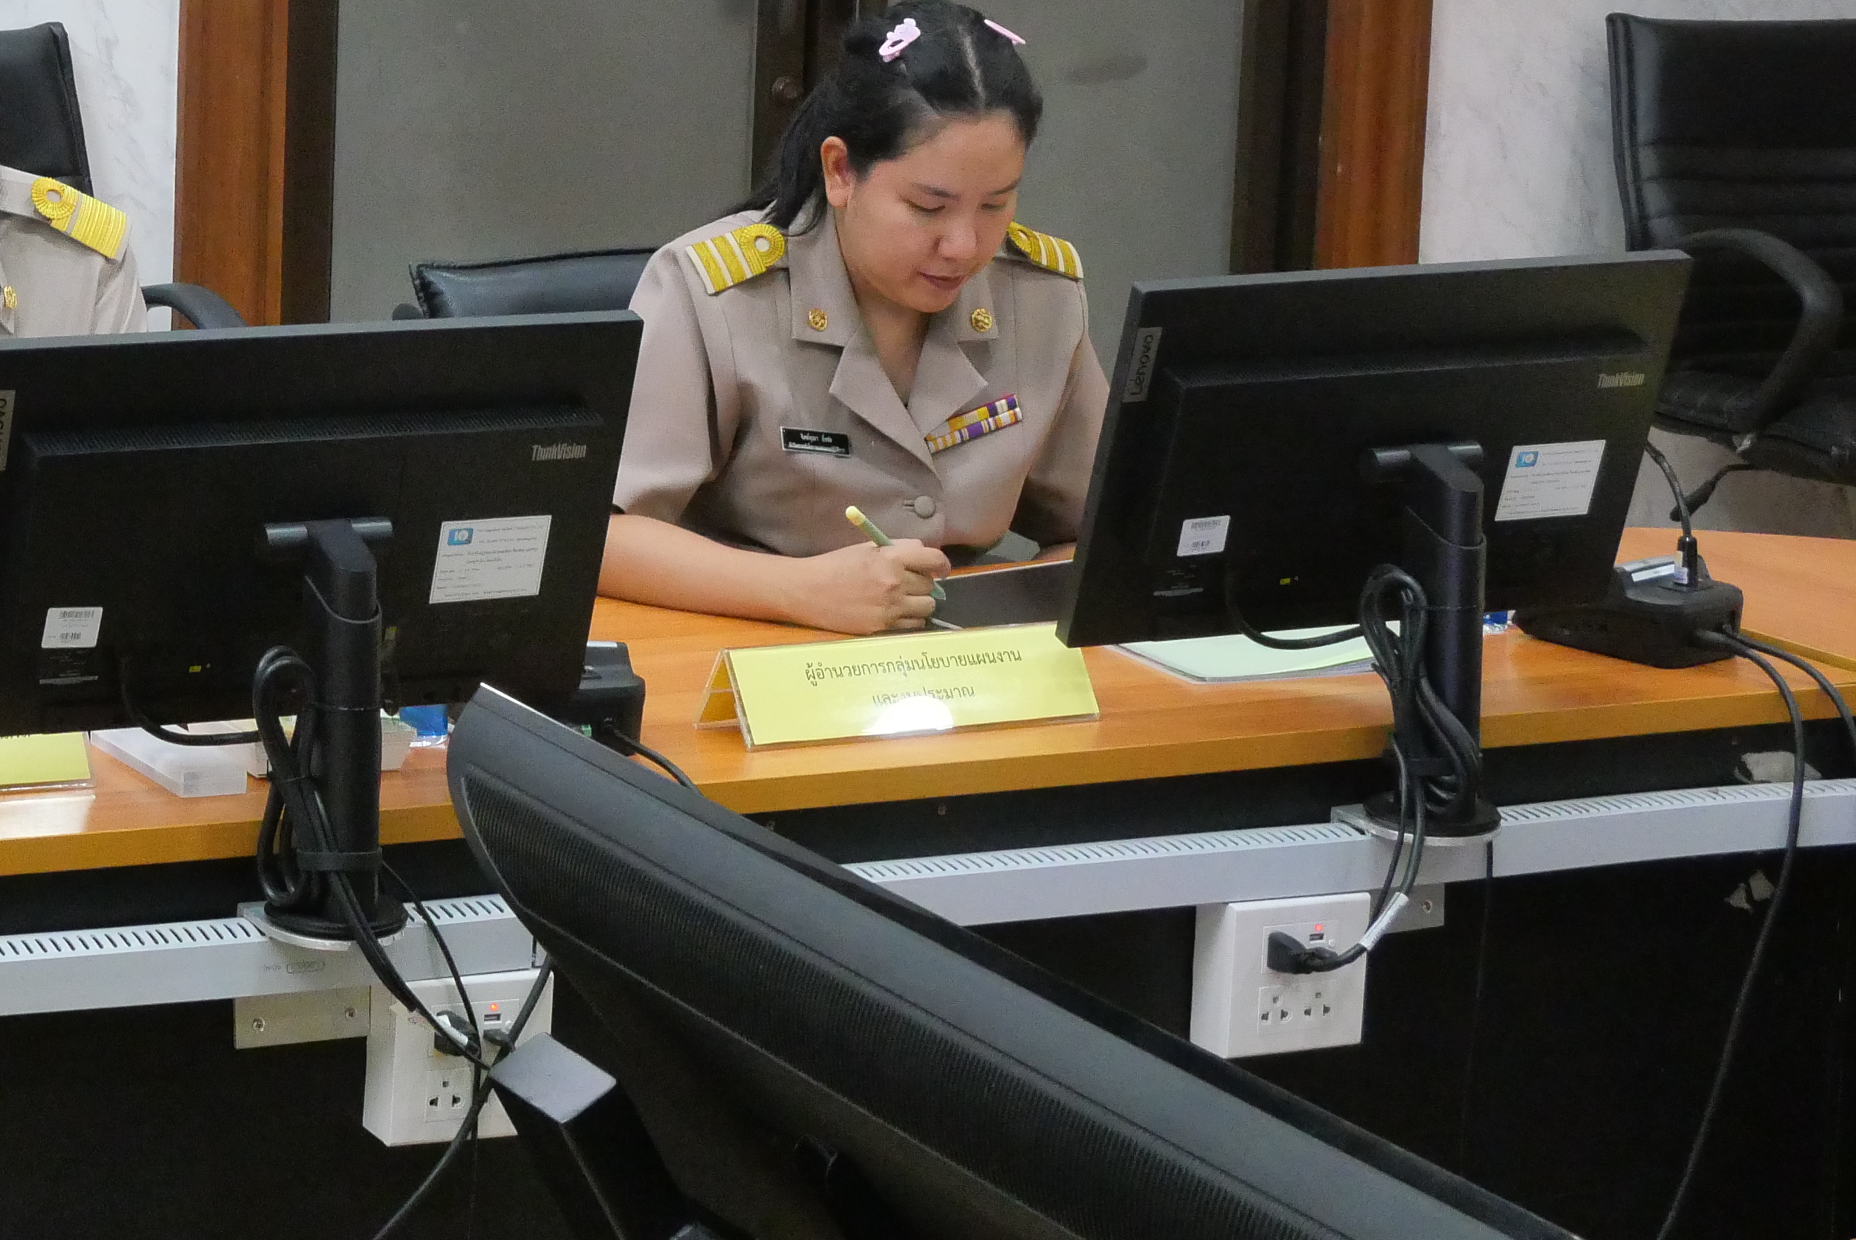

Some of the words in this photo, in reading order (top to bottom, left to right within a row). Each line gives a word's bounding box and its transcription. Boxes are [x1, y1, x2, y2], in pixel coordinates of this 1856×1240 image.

[1129, 334, 1154, 396] Lenovo
[531, 441, 587, 461] ThinkVision
[804, 647, 1022, 687] ผู้อำนวยการกลุ่มนโยบายแผนงาน
